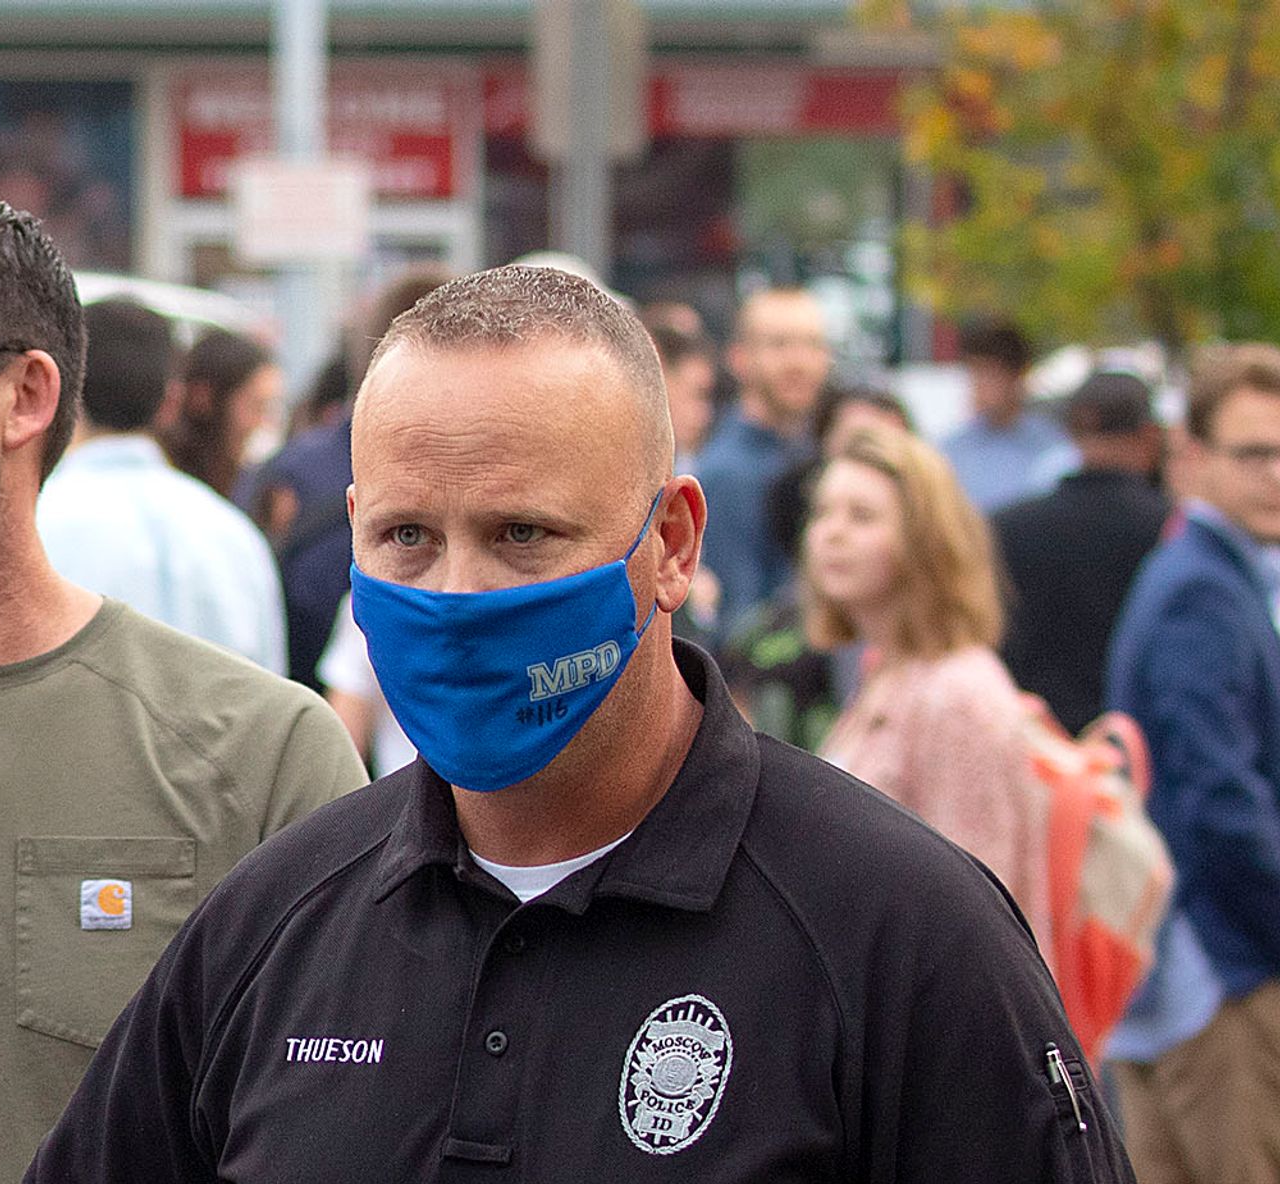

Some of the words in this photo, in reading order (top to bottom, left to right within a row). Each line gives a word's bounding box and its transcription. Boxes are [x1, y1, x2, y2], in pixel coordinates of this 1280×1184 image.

[526, 639, 621, 702] MPD
[286, 1037, 385, 1063] THUESON
[652, 1036, 712, 1060] MOSCOW
[640, 1089, 696, 1114] POLICE
[651, 1116, 673, 1131] ID
